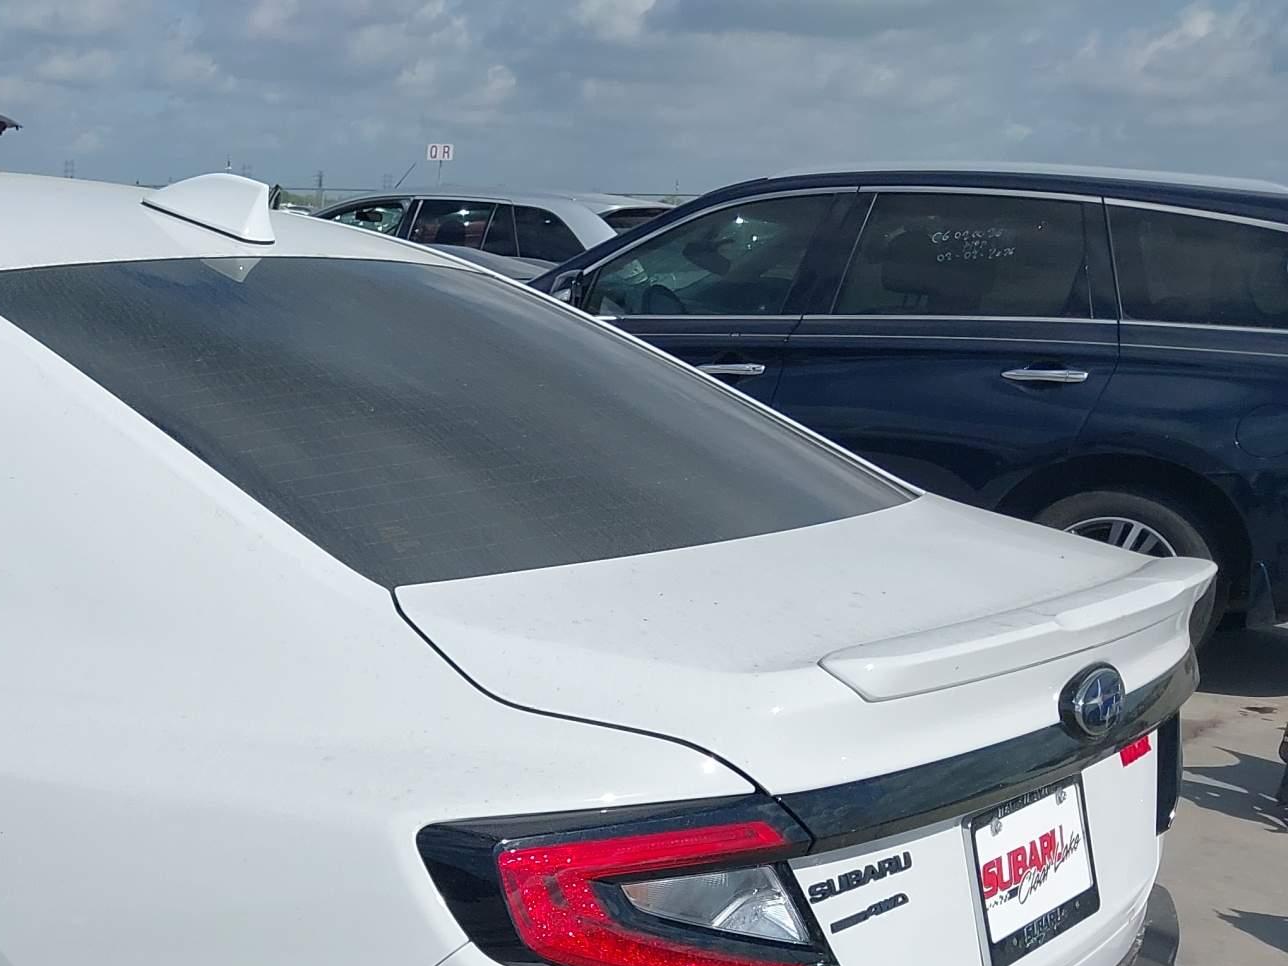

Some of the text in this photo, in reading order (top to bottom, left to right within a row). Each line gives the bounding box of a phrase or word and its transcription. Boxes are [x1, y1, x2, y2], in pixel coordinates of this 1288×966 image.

[442, 145, 450, 159] R
[807, 851, 912, 905] SUBARU
[865, 892, 910, 917] AWD
